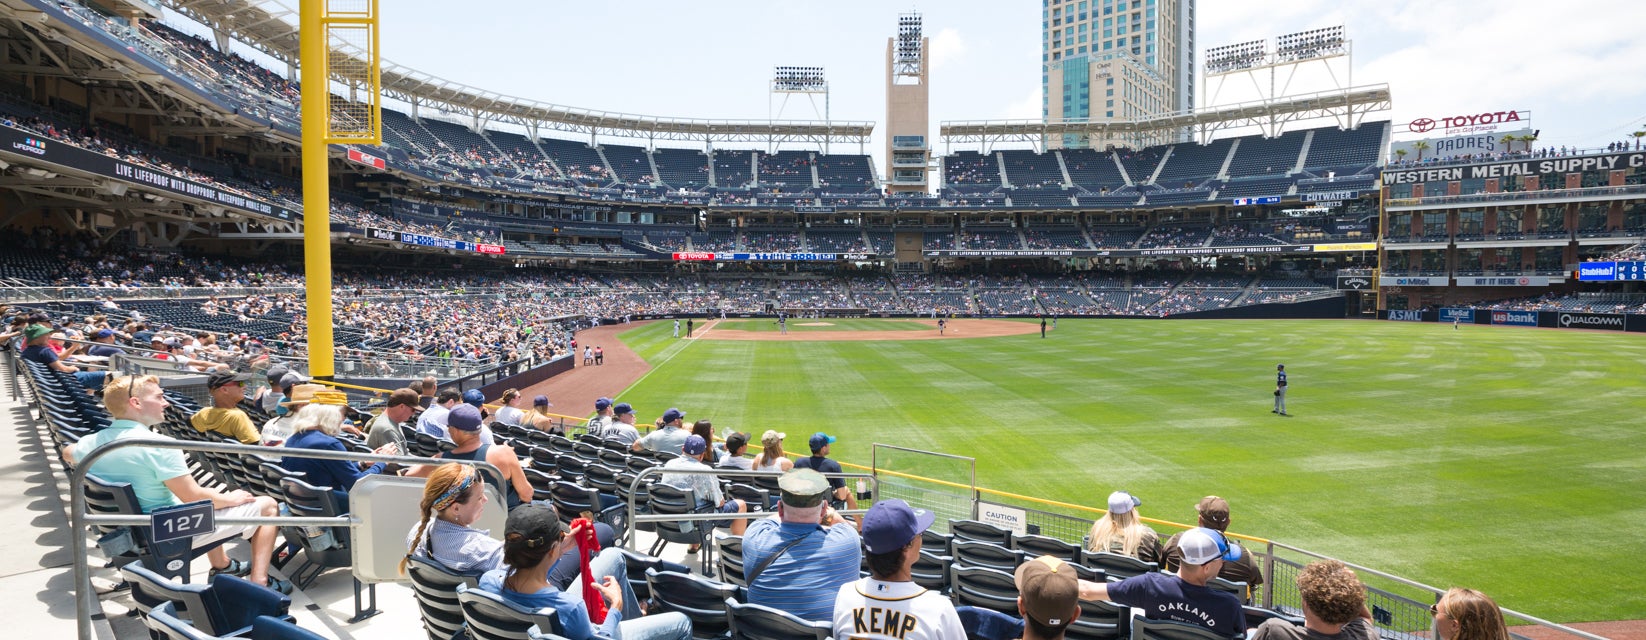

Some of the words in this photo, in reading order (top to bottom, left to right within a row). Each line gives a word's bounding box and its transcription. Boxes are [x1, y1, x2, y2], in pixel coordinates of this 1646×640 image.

[1442, 110, 1520, 128] TOYOTA
[1436, 136, 1494, 155] PADRES
[116, 163, 132, 178] LIVE
[135, 169, 169, 187] LIFEPROOF
[171, 179, 185, 191] WITH
[1383, 168, 1462, 184] WESTERN
[1472, 163, 1534, 178] METAL
[1540, 156, 1620, 173] SUPPLY
[1307, 192, 1351, 201] CUTWATER
[1581, 266, 1613, 276] StubHub!
[1389, 310, 1421, 321] ASML
[1560, 313, 1622, 327] QUALCOMM
[163, 513, 204, 533] 127
[985, 511, 1017, 522] CAUTION
[853, 607, 917, 640] KEMP
[1158, 602, 1216, 627] OAKLAND
